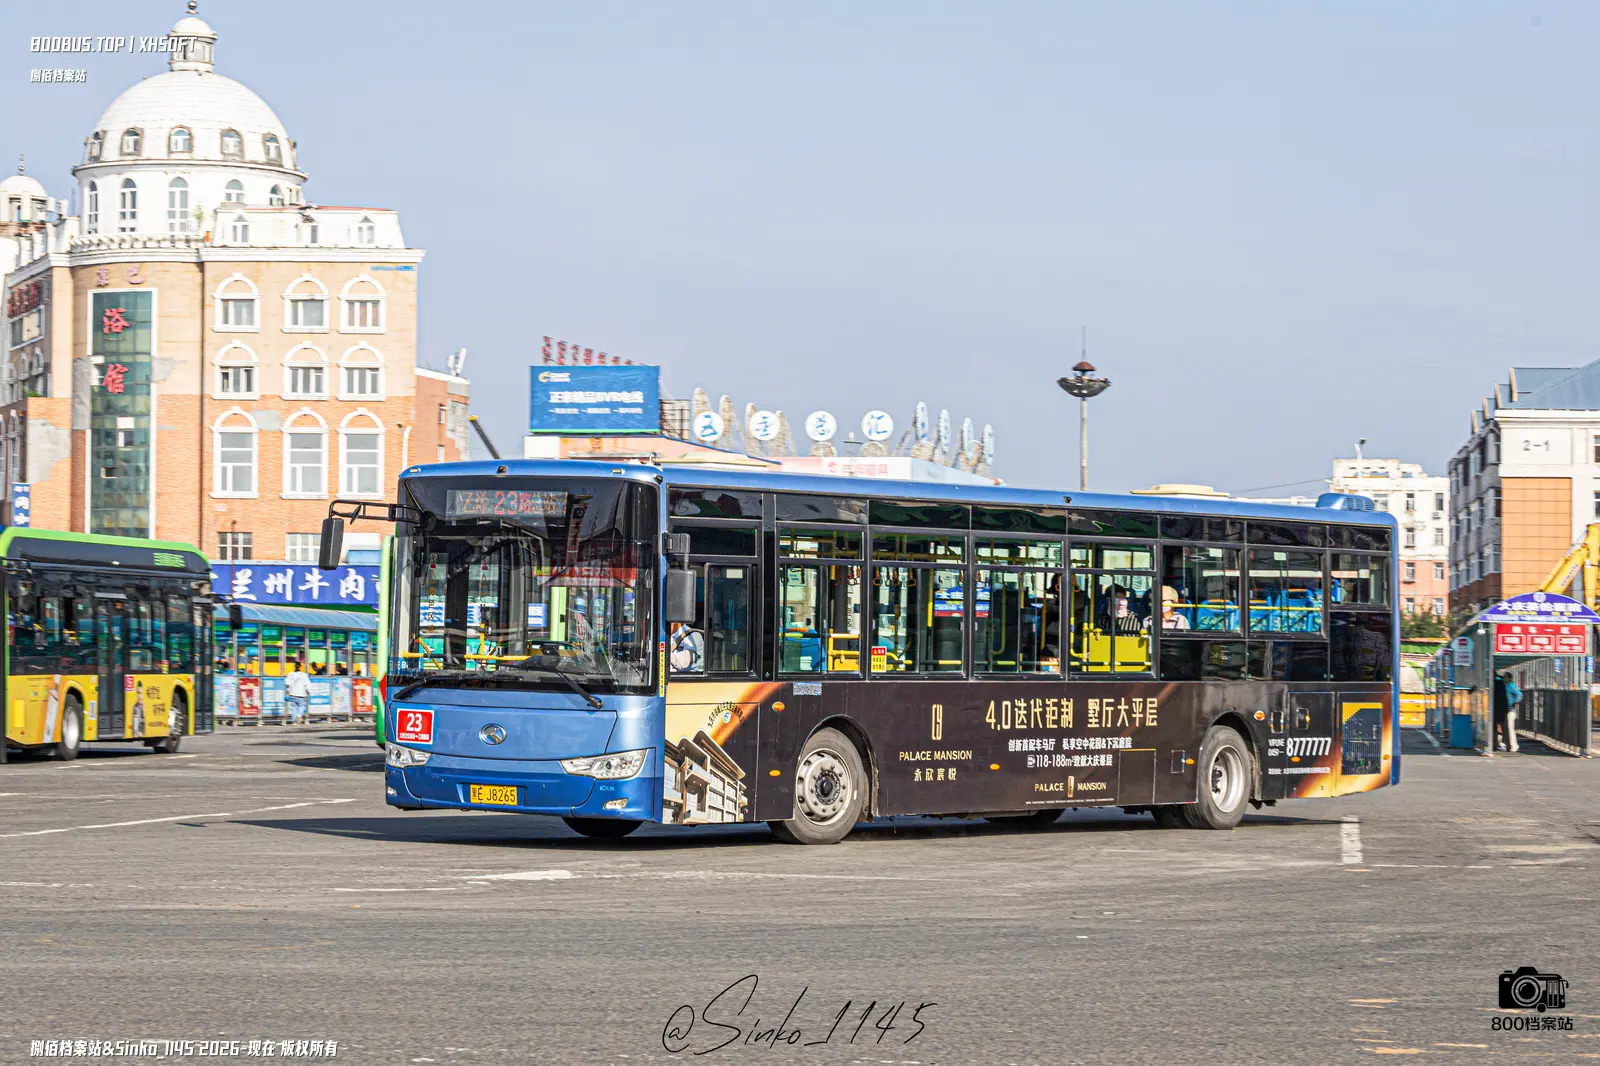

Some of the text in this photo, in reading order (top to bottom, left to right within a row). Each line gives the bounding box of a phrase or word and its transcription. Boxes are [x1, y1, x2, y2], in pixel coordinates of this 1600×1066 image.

[1522, 440, 1550, 451] 2-1
[211, 568, 380, 601] 兰州牛肉
[1087, 697, 1158, 728] 墅厅大平层
[406, 712, 423, 732] 23
[1008, 738, 1056, 752] 创新首配车马厅
[1286, 737, 1332, 757] 8777777
[899, 750, 973, 761] PALACE MANSION
[1034, 782, 1107, 792] PALACE MANSION
